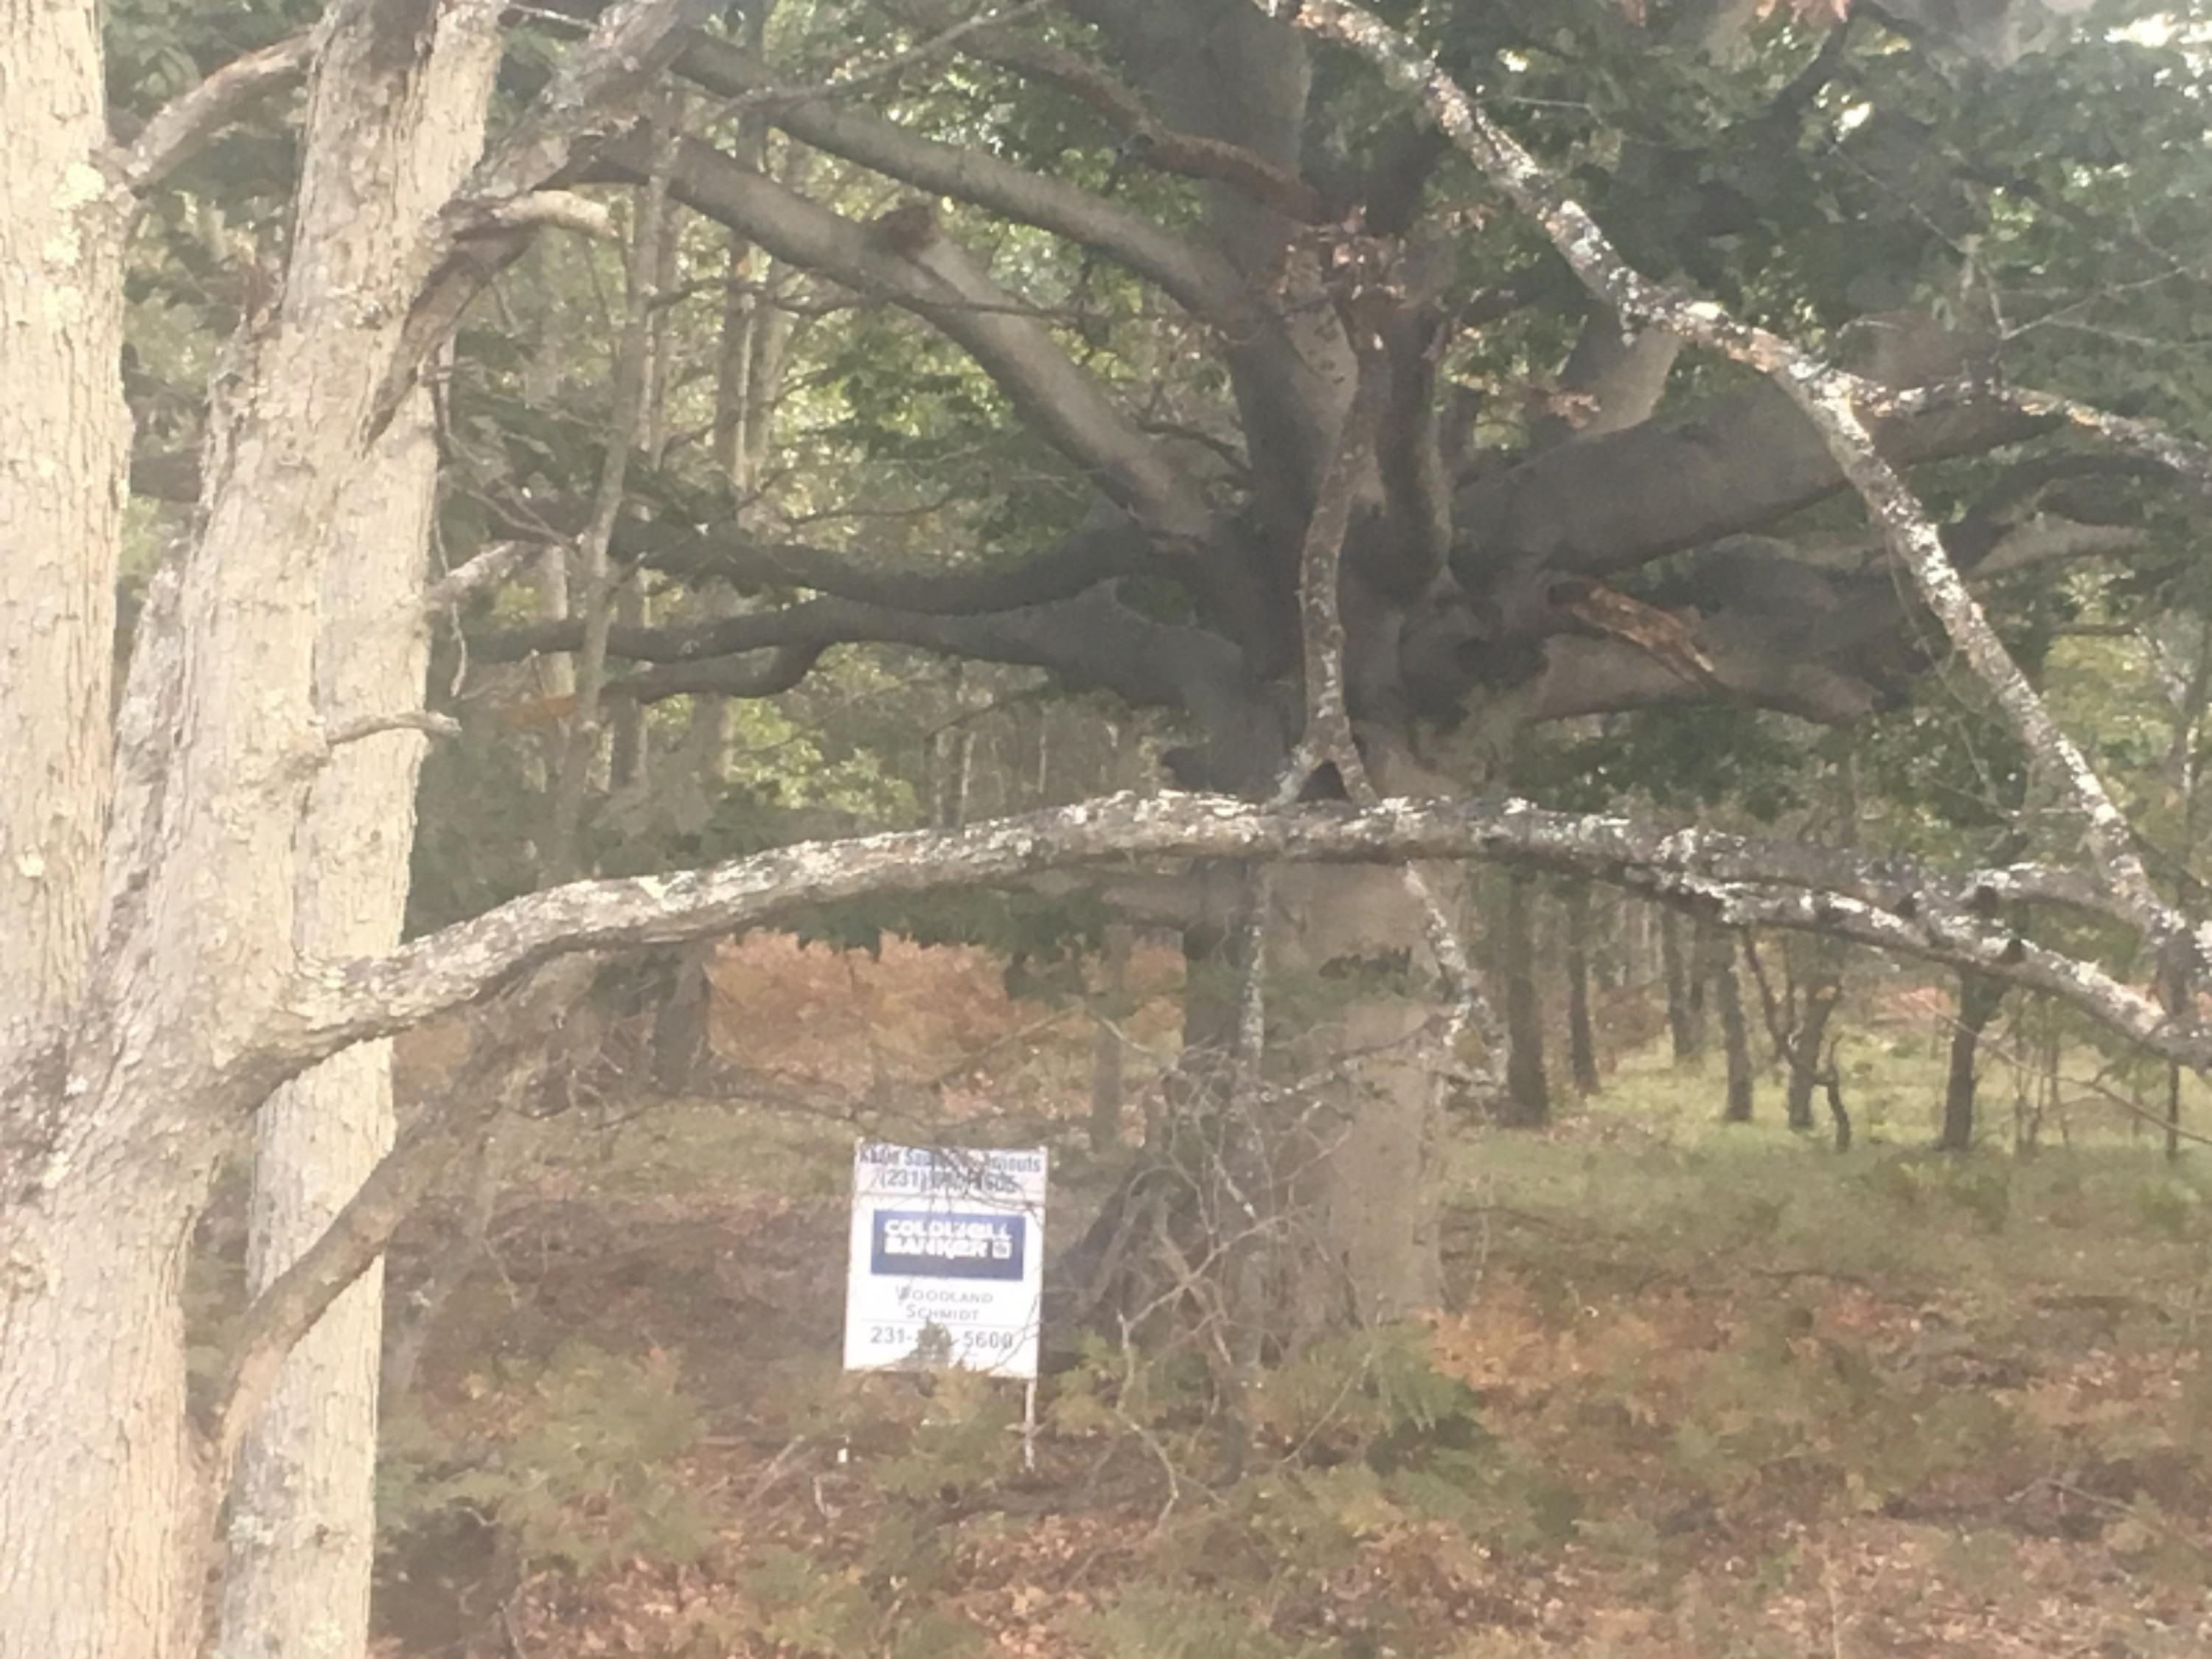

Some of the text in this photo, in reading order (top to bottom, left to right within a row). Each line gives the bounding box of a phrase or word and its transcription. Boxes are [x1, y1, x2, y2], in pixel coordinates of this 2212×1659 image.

[896, 1284, 993, 1304] WOODLAND
[906, 1304, 980, 1321] SCHMIDT
[870, 1326, 1013, 1349] 231--5600
